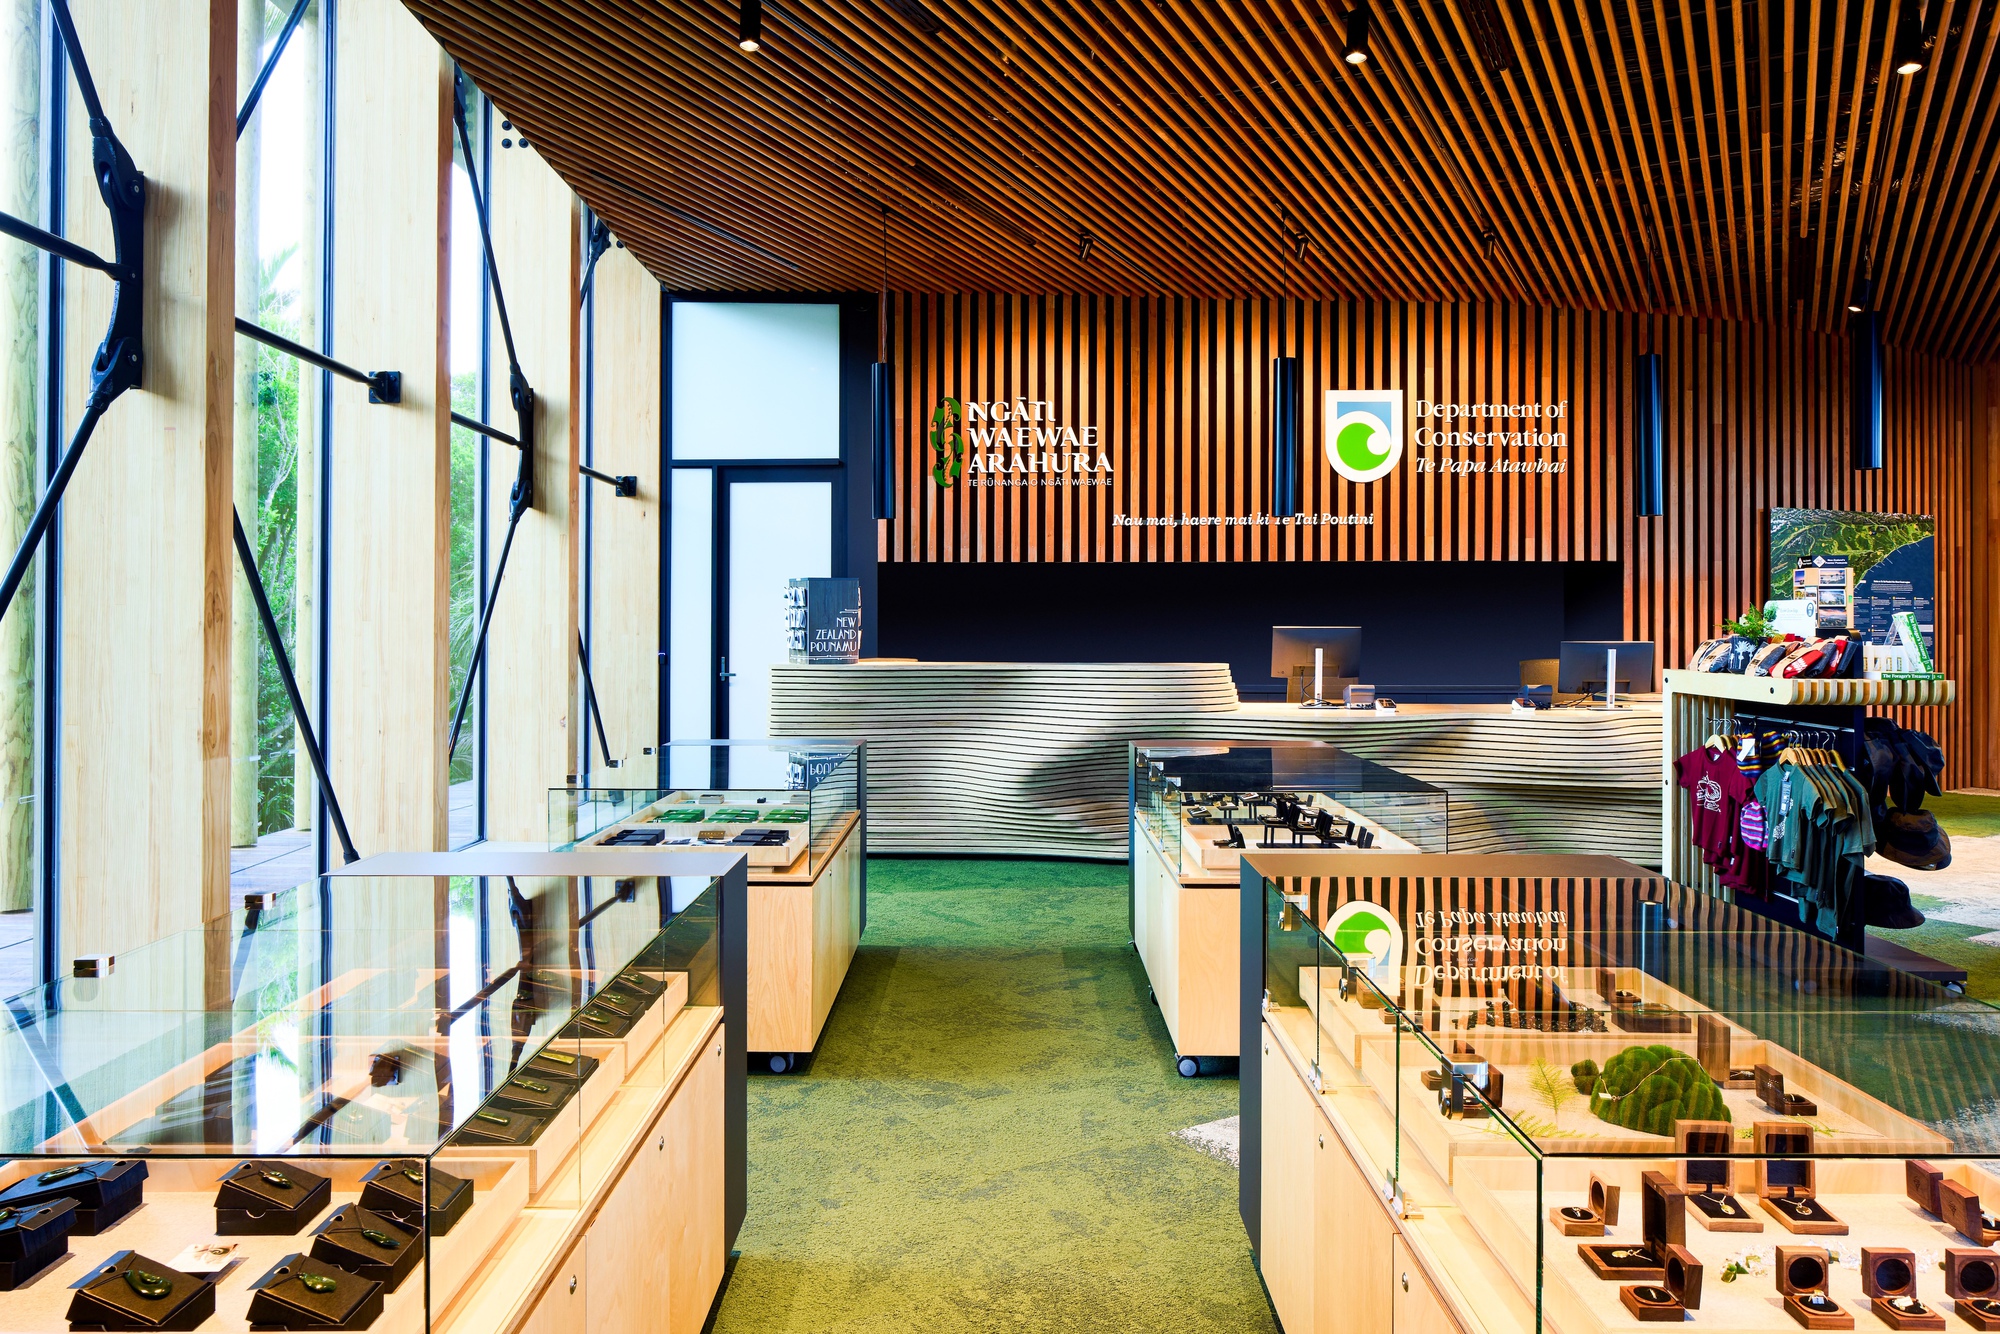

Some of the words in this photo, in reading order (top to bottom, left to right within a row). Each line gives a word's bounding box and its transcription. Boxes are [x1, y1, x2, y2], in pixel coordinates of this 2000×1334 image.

[966, 396, 1056, 422] NGĀTI
[1415, 400, 1541, 422] Department
[1545, 400, 1568, 418] of
[967, 426, 1098, 448] WAEWAE
[1414, 427, 1568, 447] Conservation
[968, 452, 1113, 474] ARAHURA
[1416, 457, 1435, 472] Te
[1438, 457, 1486, 477] Papa
[1489, 458, 1566, 474] Atawhai
[981, 477, 1028, 487] RŪNANGA
[1041, 477, 1068, 487] NGĀTI
[1070, 478, 1112, 486] WAEWAE
[1112, 514, 1143, 526] Nau
[1146, 514, 1178, 528] mai,
[1181, 513, 1222, 526] haere
[1225, 513, 1252, 526] mai
[1256, 512, 1269, 526] ki
[1294, 513, 1318, 526] Tai
[1320, 513, 1374, 525] Poutini
[836, 617, 856, 628] NEW
[816, 629, 856, 640] ZEALAND
[810, 642, 856, 652] POUNAMU
